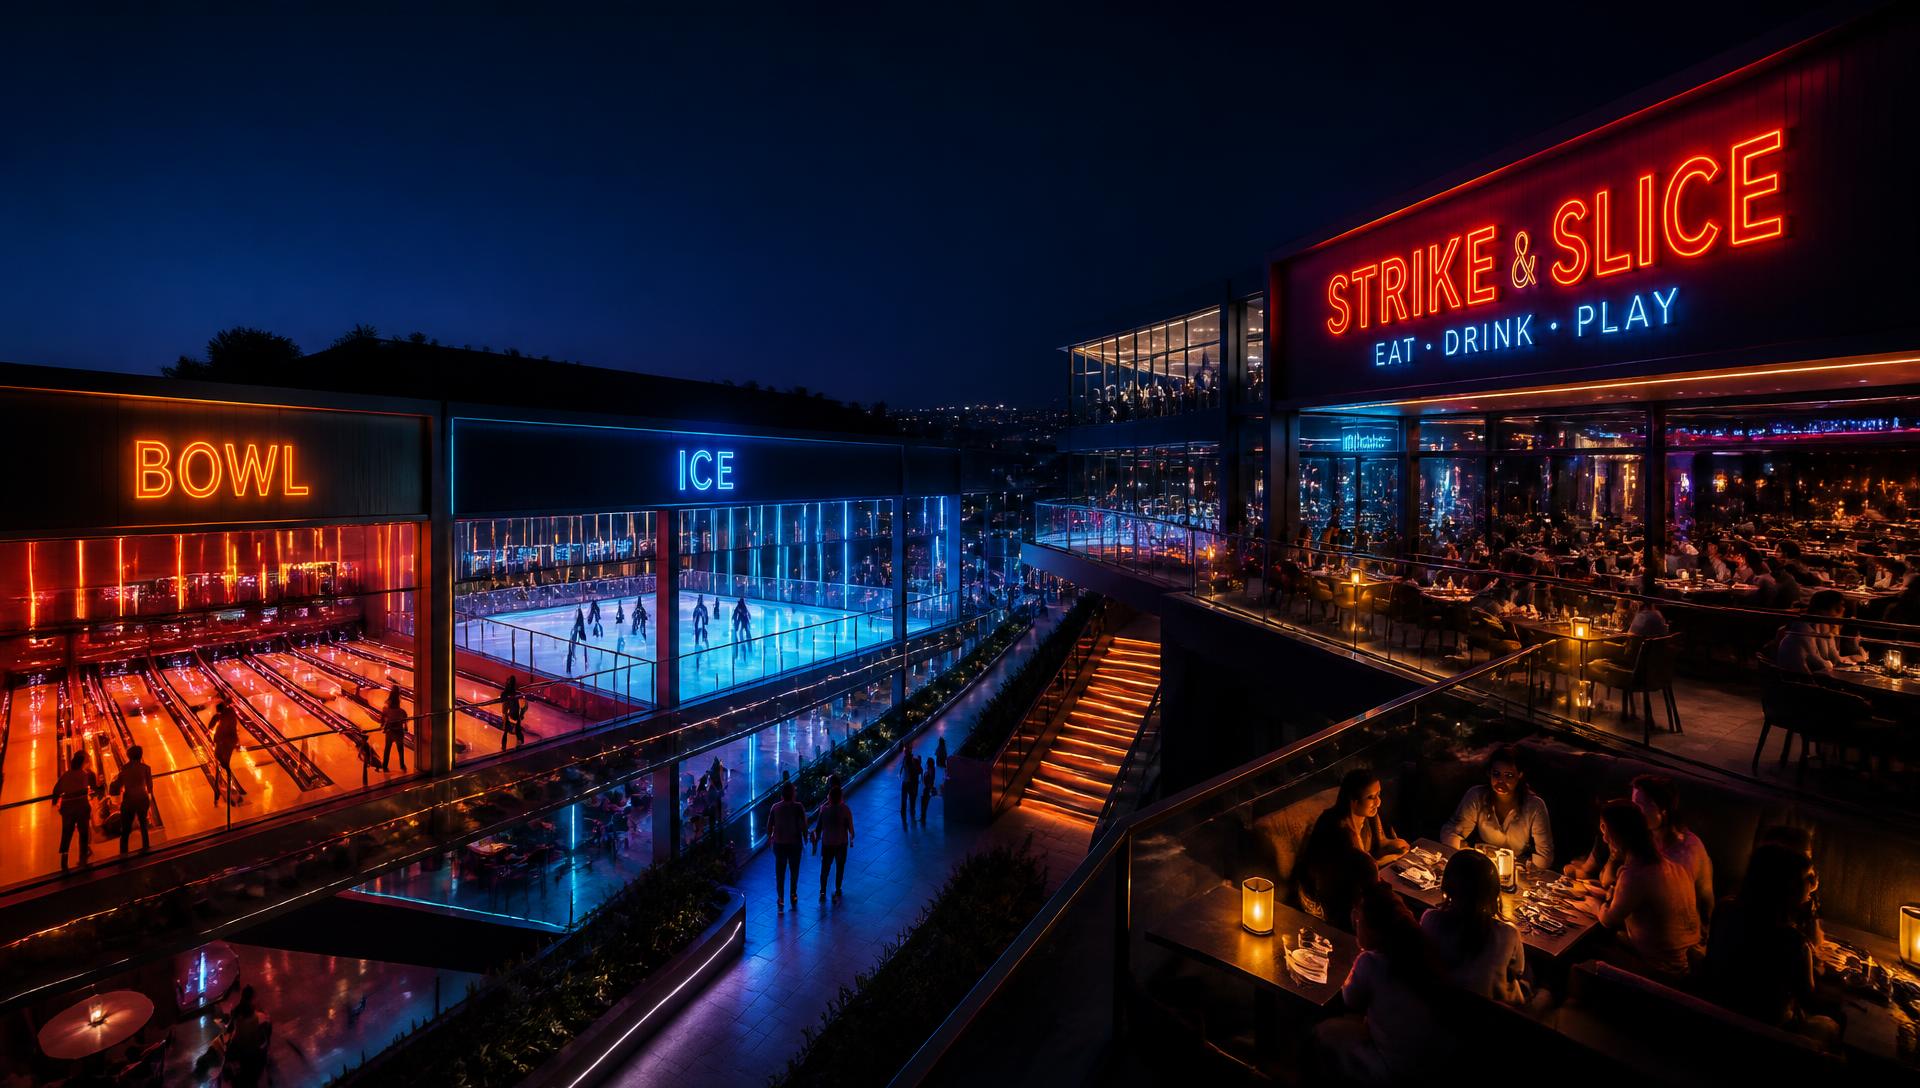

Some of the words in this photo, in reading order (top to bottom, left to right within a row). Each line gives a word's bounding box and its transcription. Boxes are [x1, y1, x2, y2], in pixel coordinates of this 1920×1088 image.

[1326, 223, 1498, 337] STRIKE
[1510, 229, 1538, 290] &
[1549, 126, 1785, 289] SLICE
[1375, 336, 1416, 367] EAT
[1443, 313, 1534, 357] DRINK
[1577, 286, 1679, 337] PLAY
[134, 438, 311, 501] BOWL
[677, 447, 736, 493] ICE
